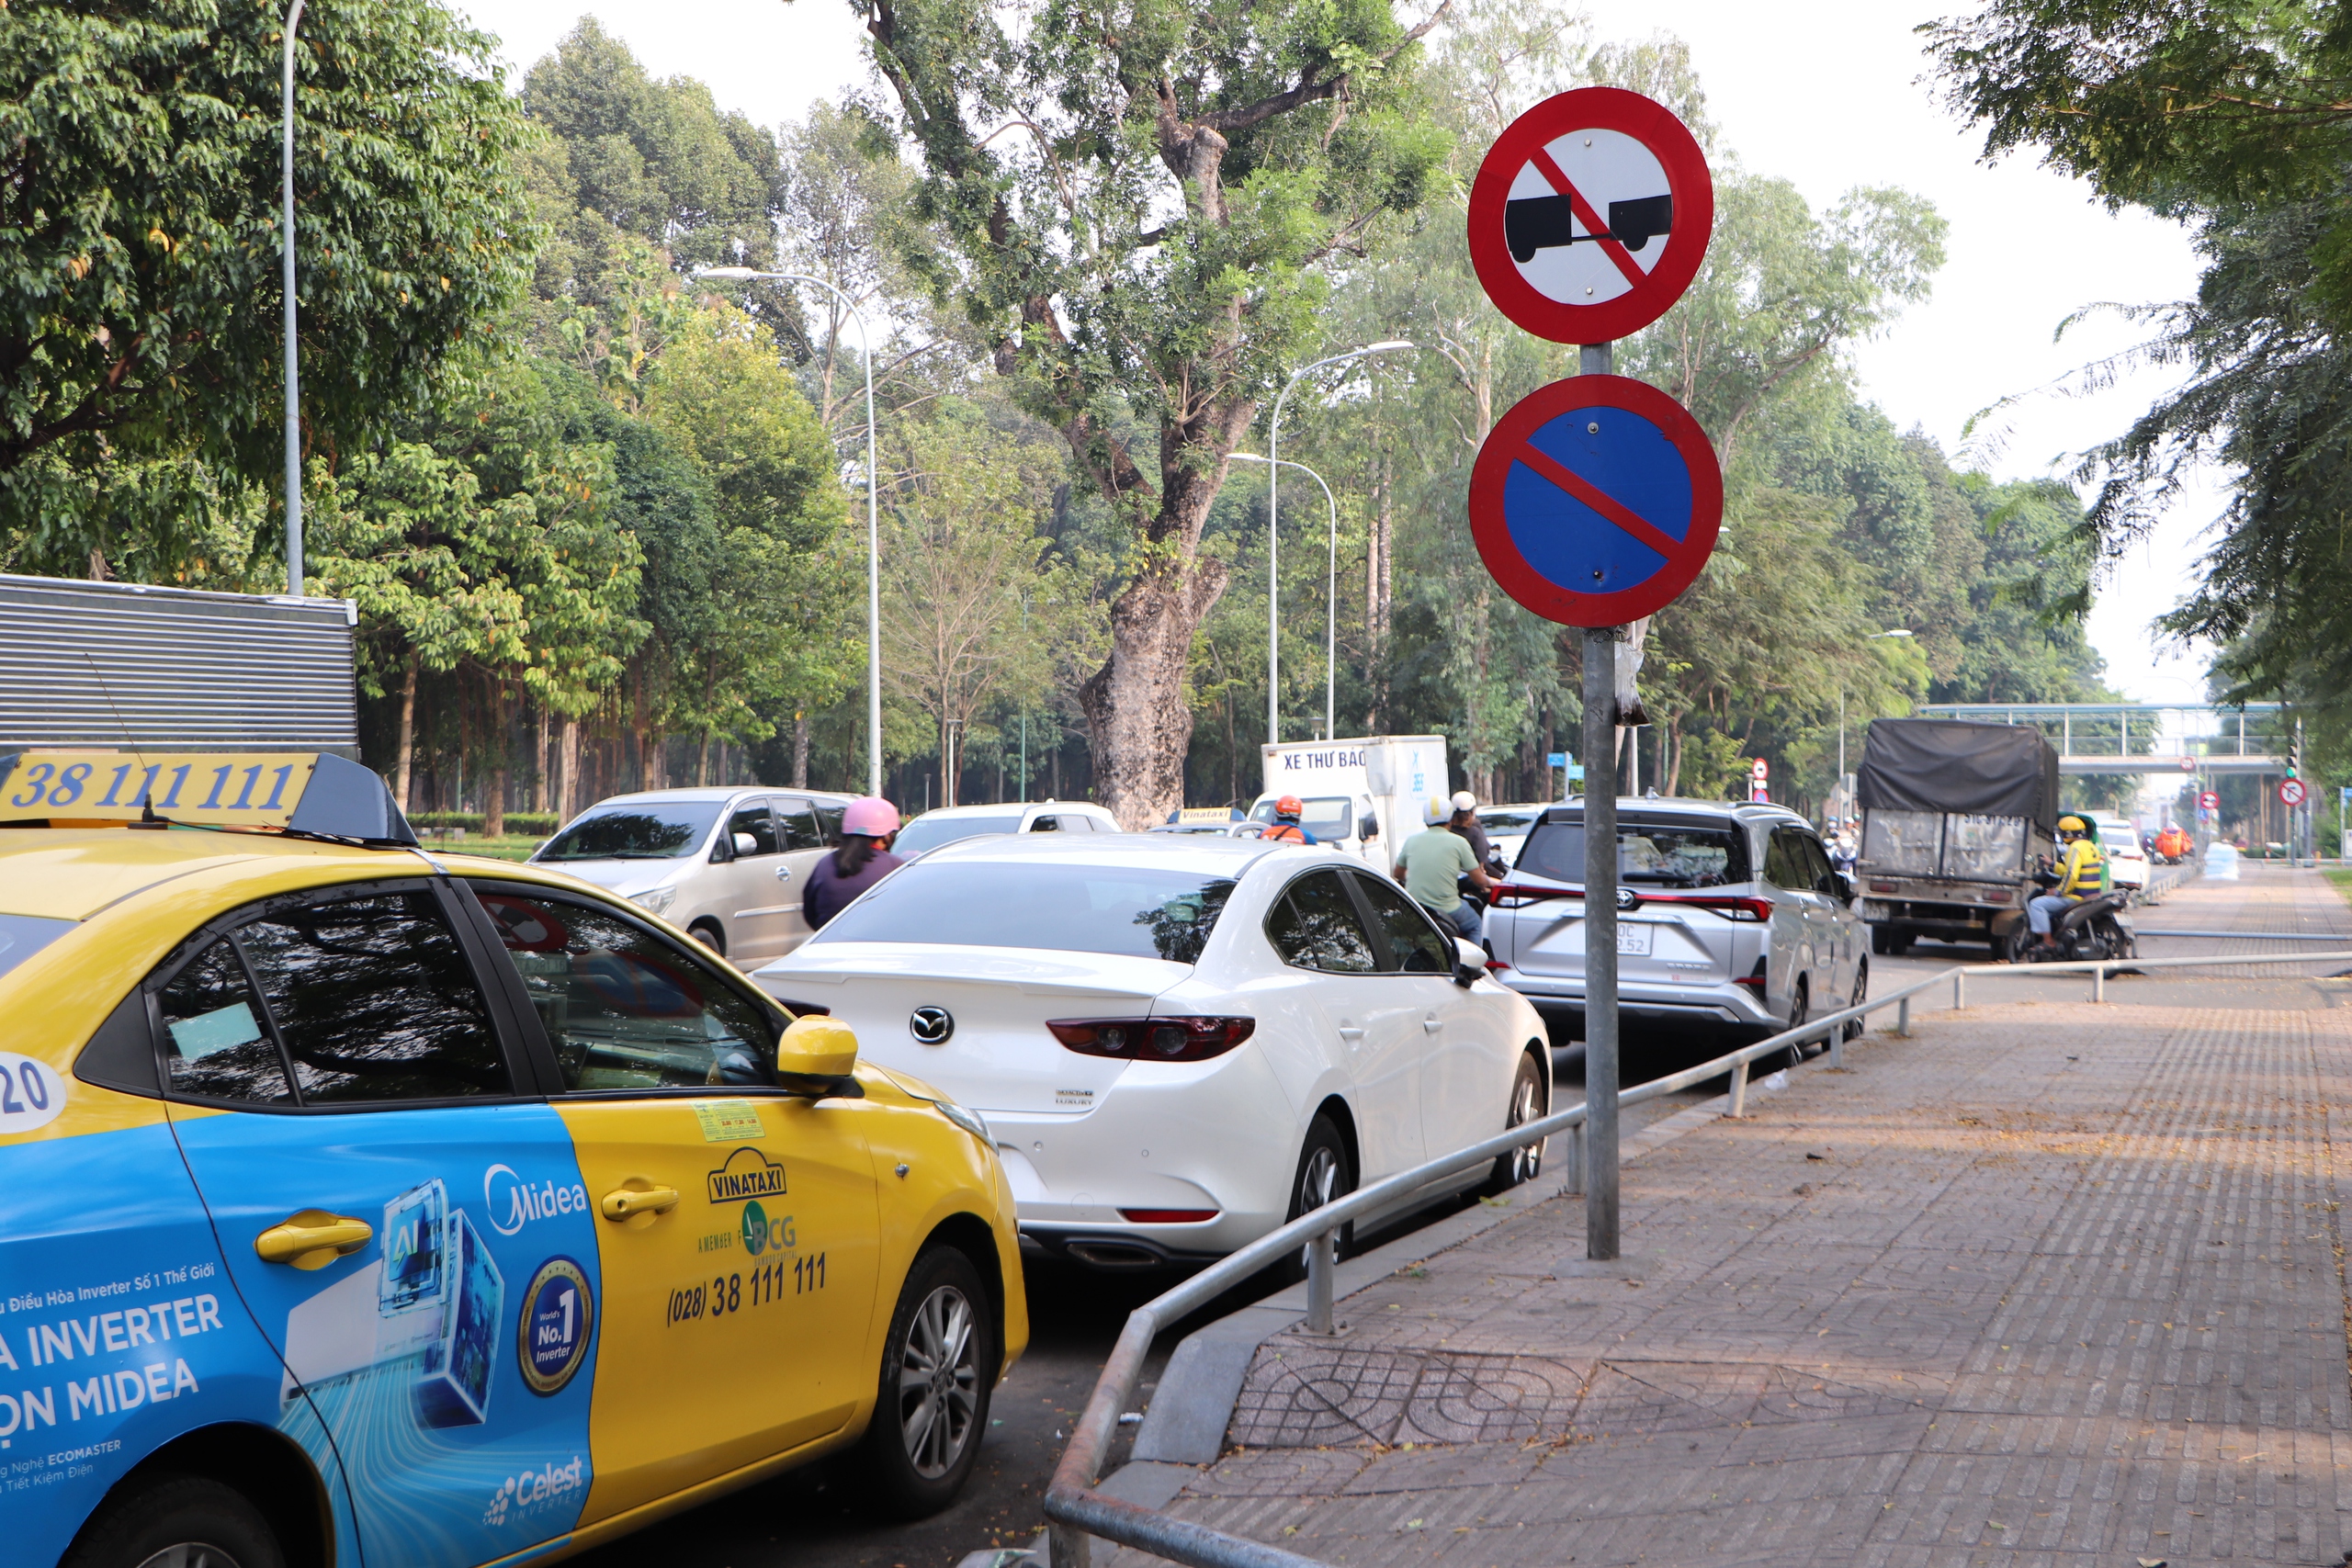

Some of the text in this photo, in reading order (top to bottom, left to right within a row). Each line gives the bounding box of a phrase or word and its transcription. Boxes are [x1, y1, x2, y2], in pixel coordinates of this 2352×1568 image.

[1284, 754, 1301, 770] XE
[1306, 750, 1335, 769] THƯ
[12, 763, 293, 810] 38 111 111
[1183, 809, 1228, 819] Vinataxi
[0, 1061, 49, 1114] 20
[713, 1169, 781, 1198] VINATAXI
[494, 1172, 586, 1235] Midea
[704, 1232, 732, 1252] MEMBER
[752, 1215, 797, 1257] BCG
[776, 1250, 797, 1263] CAPITAL
[9, 1292, 43, 1313] Điều
[46, 1291, 74, 1306] Hòa
[78, 1280, 131, 1301] Inverter
[134, 1272, 152, 1291] Số
[154, 1274, 161, 1287] 1
[164, 1265, 187, 1285] Thế
[190, 1262, 215, 1280] Giới
[667, 1252, 825, 1328] (028) 38 111 111
[28, 1293, 223, 1367] INVERTER
[539, 1310, 560, 1322] World's
[537, 1346, 571, 1363] Inverter
[67, 1359, 199, 1421] MIDEA
[12, 1456, 44, 1473] Nghệ
[48, 1439, 121, 1466] ECOMASTER
[6, 1476, 29, 1492] Tiết
[34, 1472, 64, 1486] Kiệm
[69, 1463, 94, 1479] Điện
[516, 1455, 582, 1506] Celest
[512, 1489, 582, 1522] INVERTER
